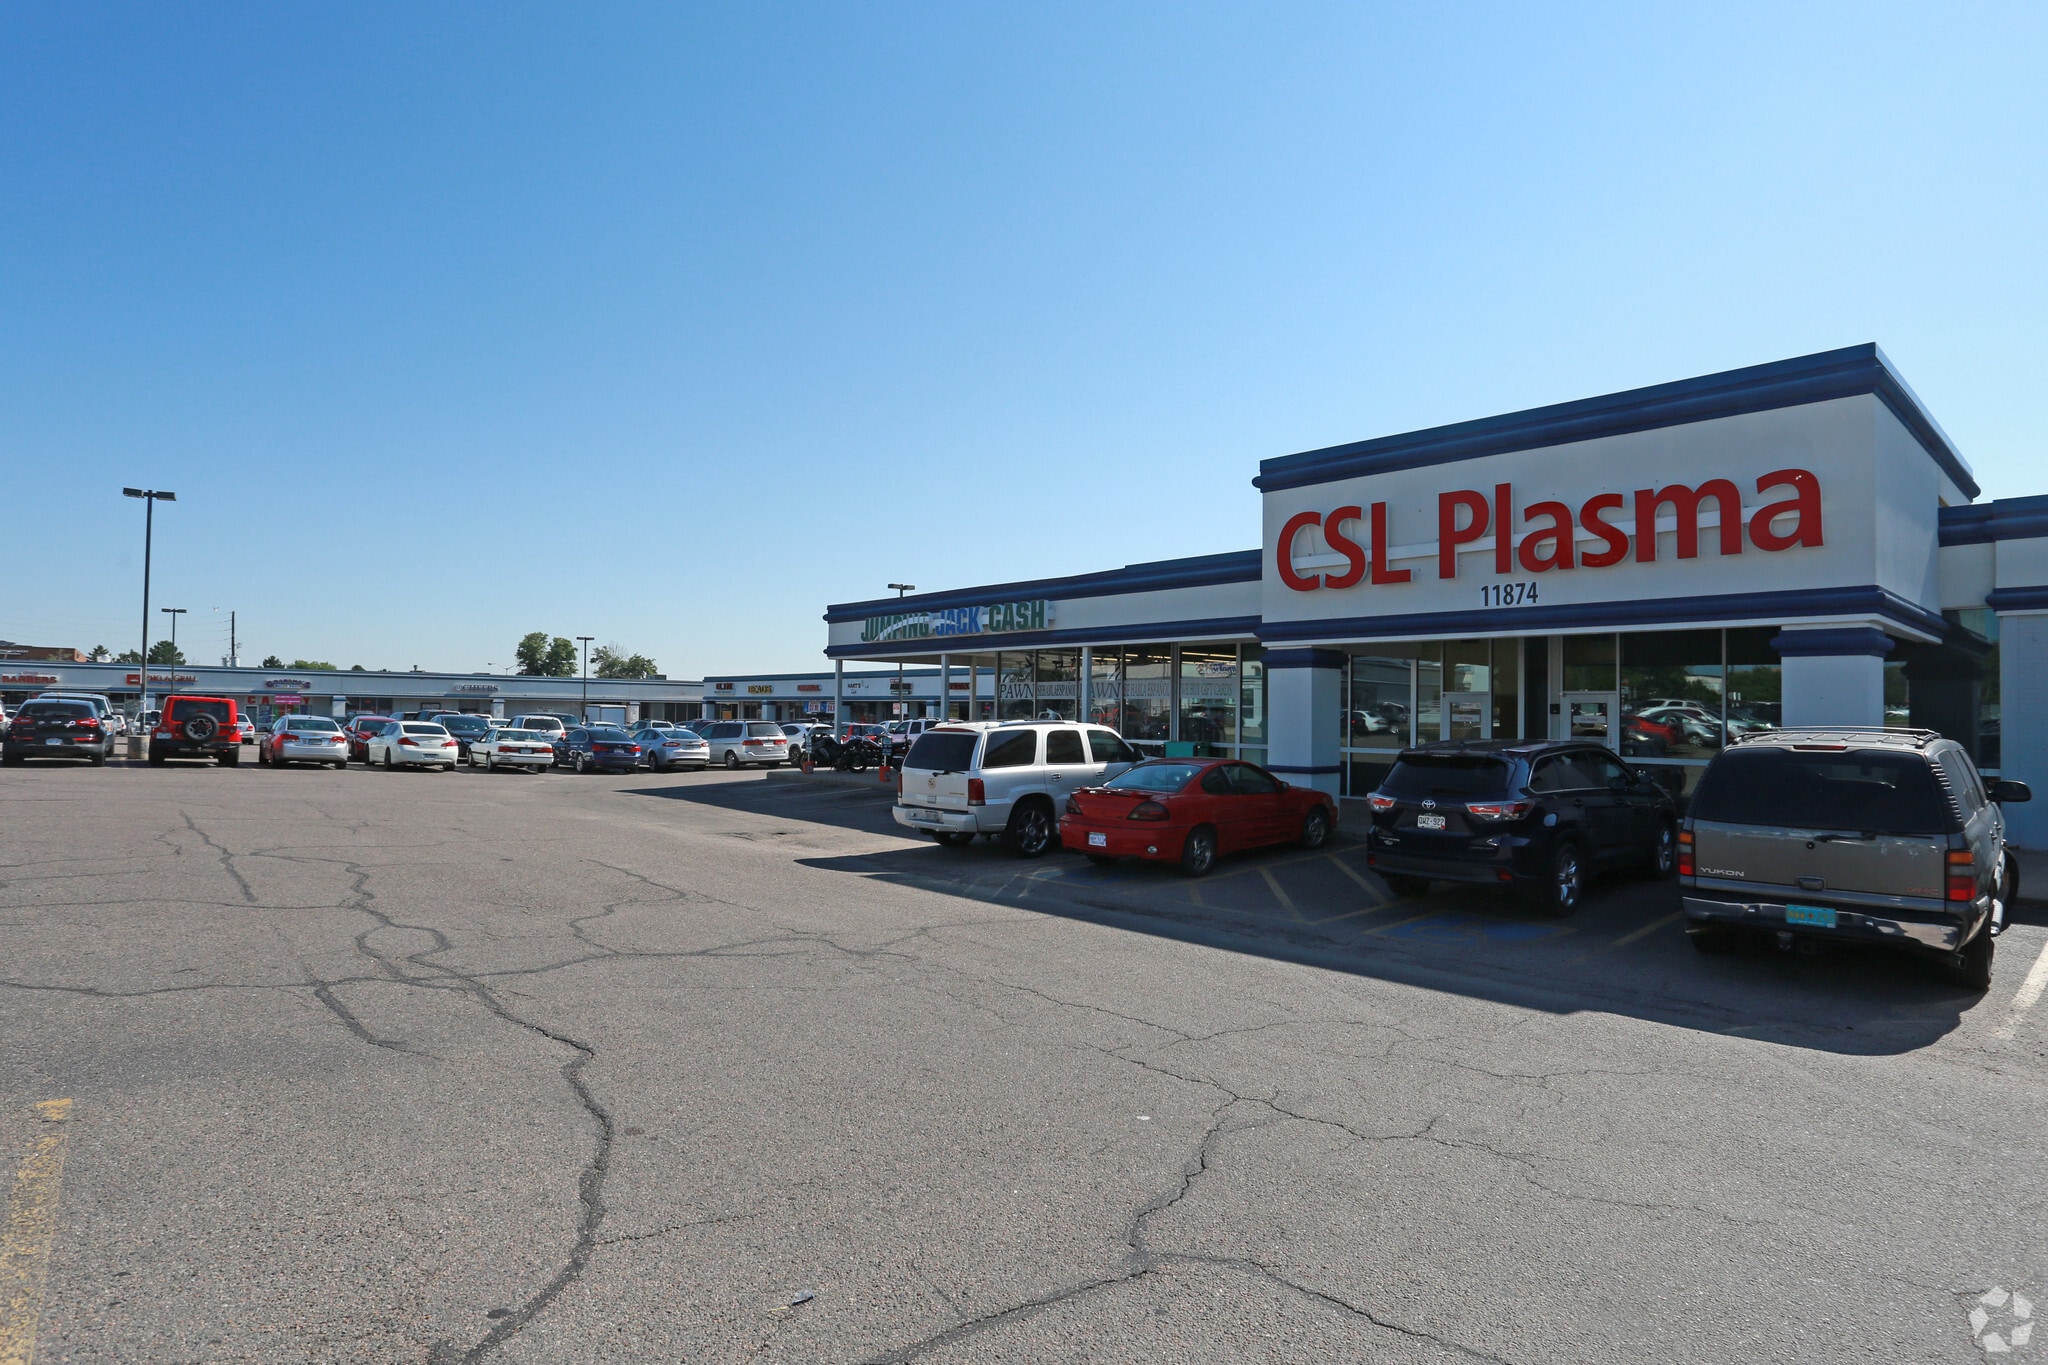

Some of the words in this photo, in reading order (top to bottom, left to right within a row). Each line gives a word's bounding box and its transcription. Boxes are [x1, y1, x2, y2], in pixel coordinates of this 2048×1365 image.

[1277, 502, 1411, 591] CSL
[1439, 469, 1823, 579] Plasma
[1481, 582, 1538, 606] 11874
[861, 612, 930, 642] JUMPING
[935, 606, 981, 637] JACK
[988, 601, 1045, 632] CASH
[2, 675, 58, 684] BARBERS
[1000, 684, 1034, 699] PAWN
[1091, 682, 1121, 699] AWN
[247, 696, 311, 704] CAY
[1700, 867, 1745, 877] YUKON
